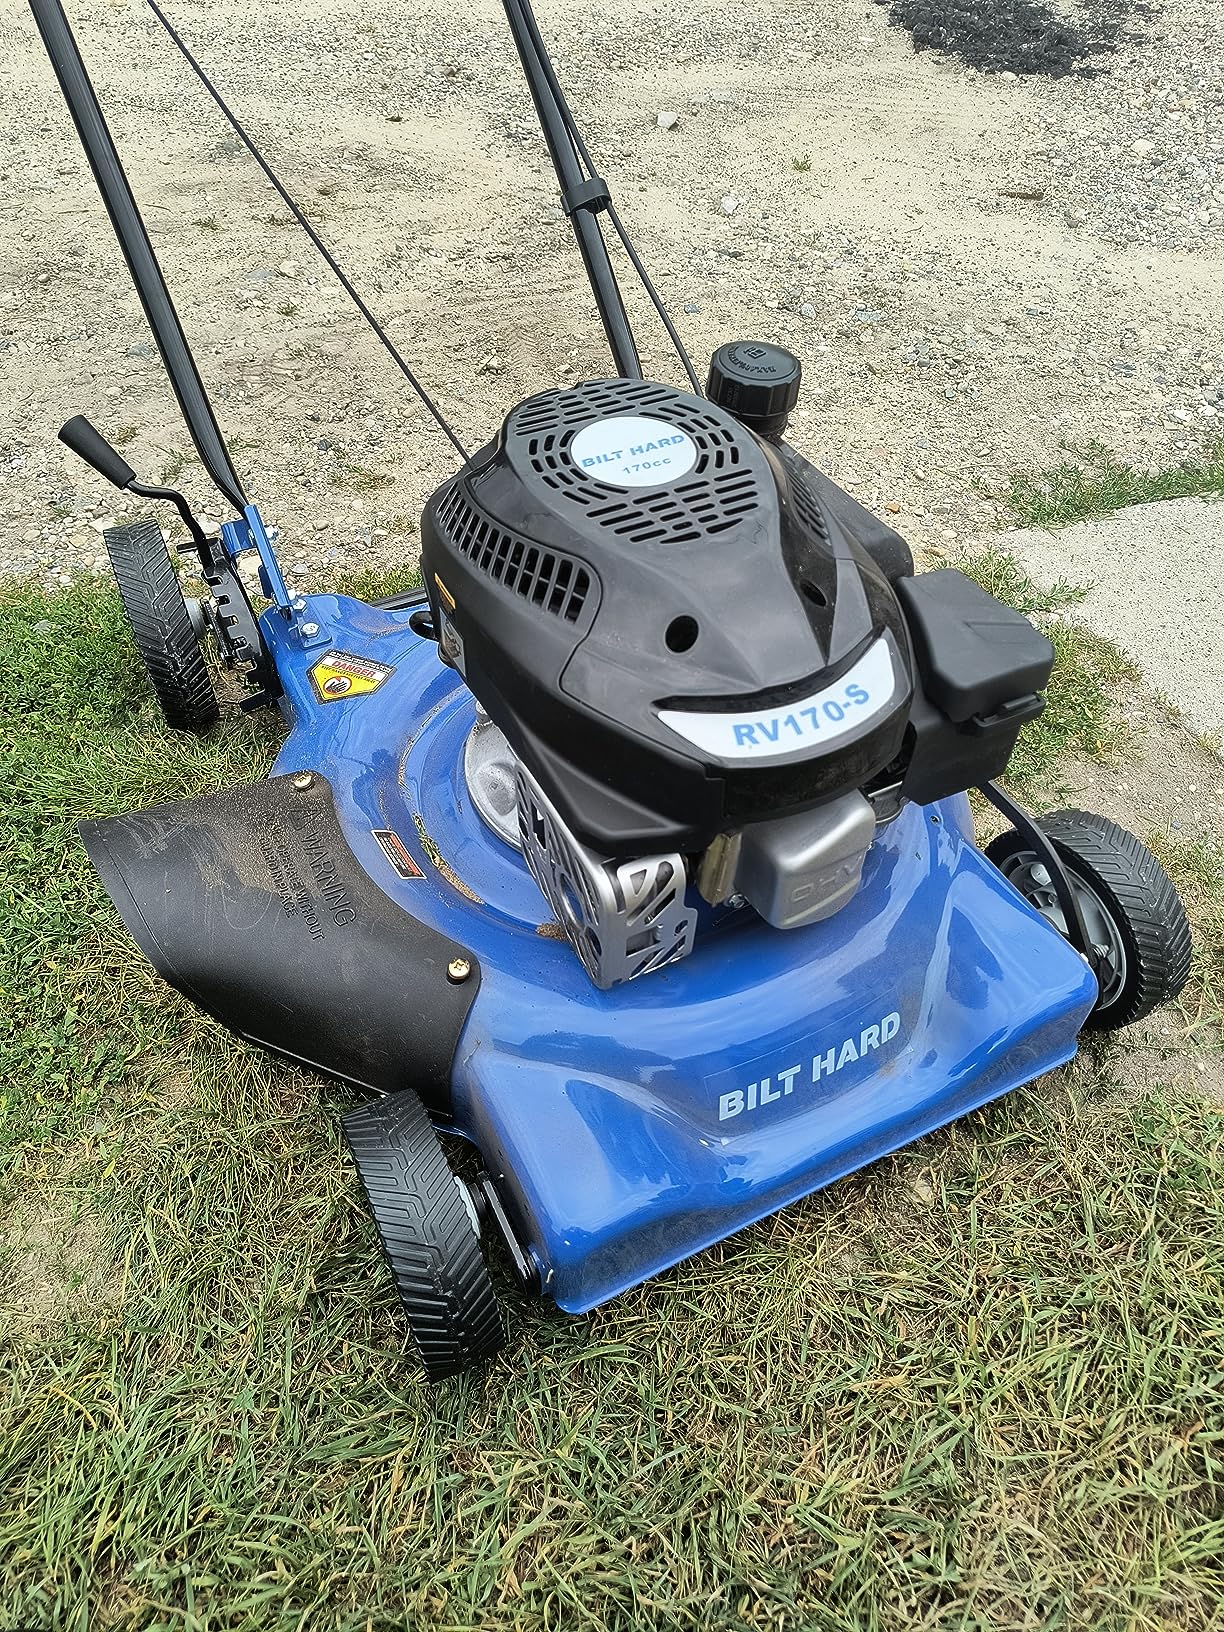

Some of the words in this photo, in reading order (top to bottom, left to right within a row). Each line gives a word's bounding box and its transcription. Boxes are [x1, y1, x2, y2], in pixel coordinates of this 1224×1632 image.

[582, 450, 623, 467] BILT
[629, 435, 685, 455] HARD
[623, 458, 671, 474] 170cc
[332, 660, 376, 678] DANGER
[732, 684, 870, 747] RV170-S
[258, 838, 279, 868] GUARD
[276, 882, 298, 918] PLACE
[300, 829, 358, 927] WARNING
[296, 888, 324, 940] WITHOUT
[718, 1064, 801, 1121] BILT
[811, 1011, 900, 1083] HARD
